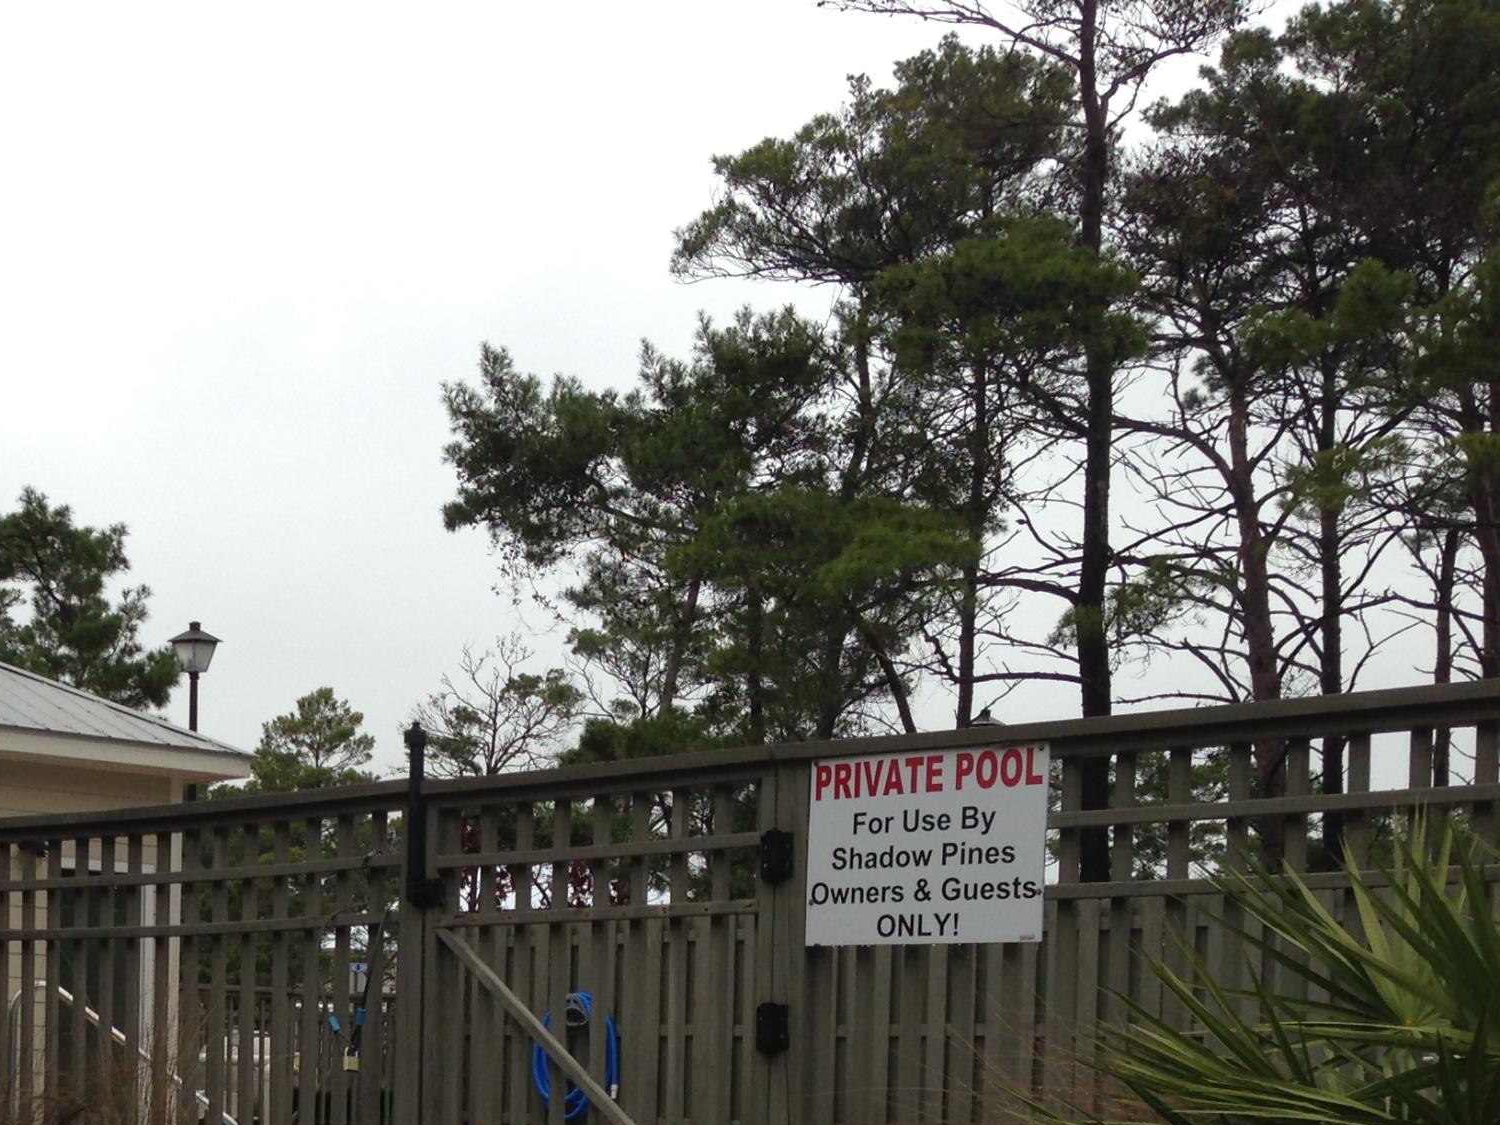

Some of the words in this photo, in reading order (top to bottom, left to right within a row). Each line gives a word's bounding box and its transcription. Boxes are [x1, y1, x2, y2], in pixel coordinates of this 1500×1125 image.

[815, 755, 944, 801] PRIVATE
[955, 747, 1043, 790] POOL
[853, 812, 895, 834] For
[903, 809, 951, 832] Use
[962, 806, 996, 835] By
[832, 846, 932, 870] Shadow
[942, 842, 1016, 866] Pines
[811, 882, 904, 905] Owners
[914, 878, 932, 902] &
[942, 876, 1038, 901] Guests
[877, 913, 960, 937] ONLY!
